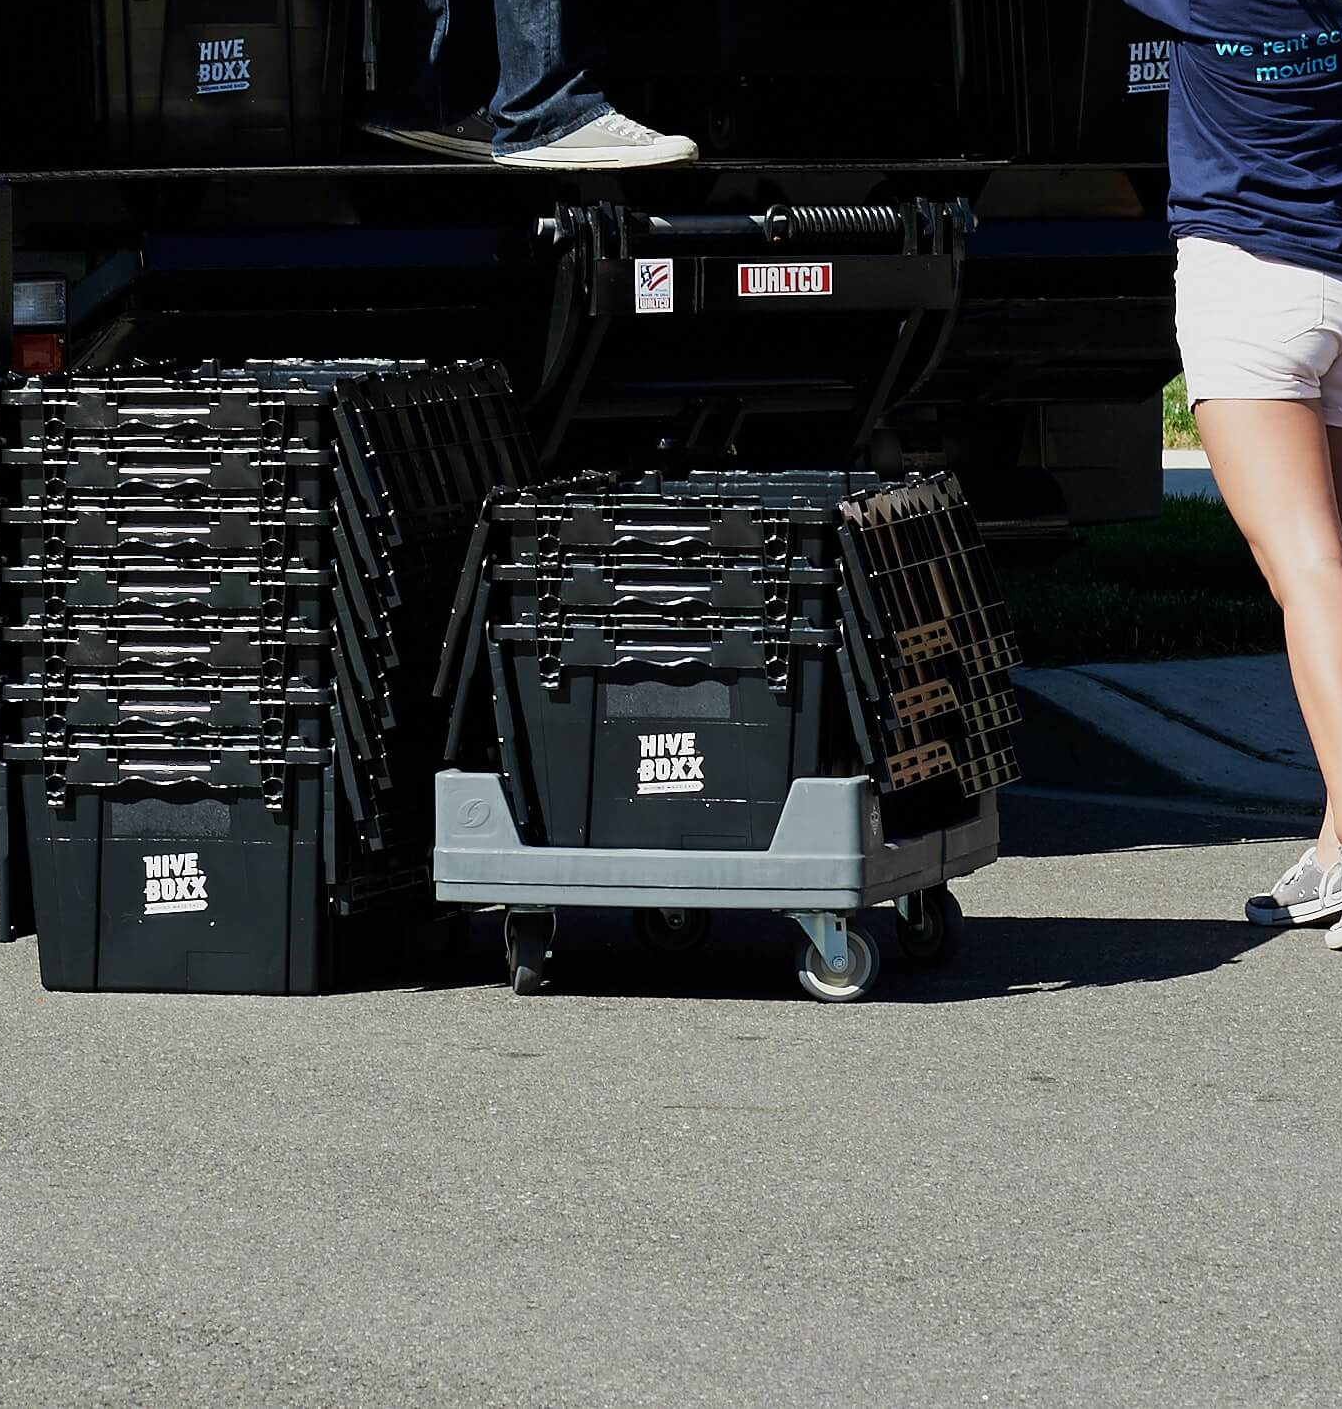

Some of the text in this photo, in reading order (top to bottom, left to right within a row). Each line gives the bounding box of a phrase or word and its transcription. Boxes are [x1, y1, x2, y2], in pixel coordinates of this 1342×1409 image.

[198, 39, 245, 61] HIVE
[1263, 33, 1310, 56] rent
[197, 59, 251, 83] BOXX
[1255, 55, 1337, 82] moving
[747, 265, 824, 294] WALTCO
[637, 732, 696, 758] HIVE
[636, 756, 705, 782] BOXX
[142, 852, 198, 879] HIVE
[142, 876, 209, 902] BOXX
